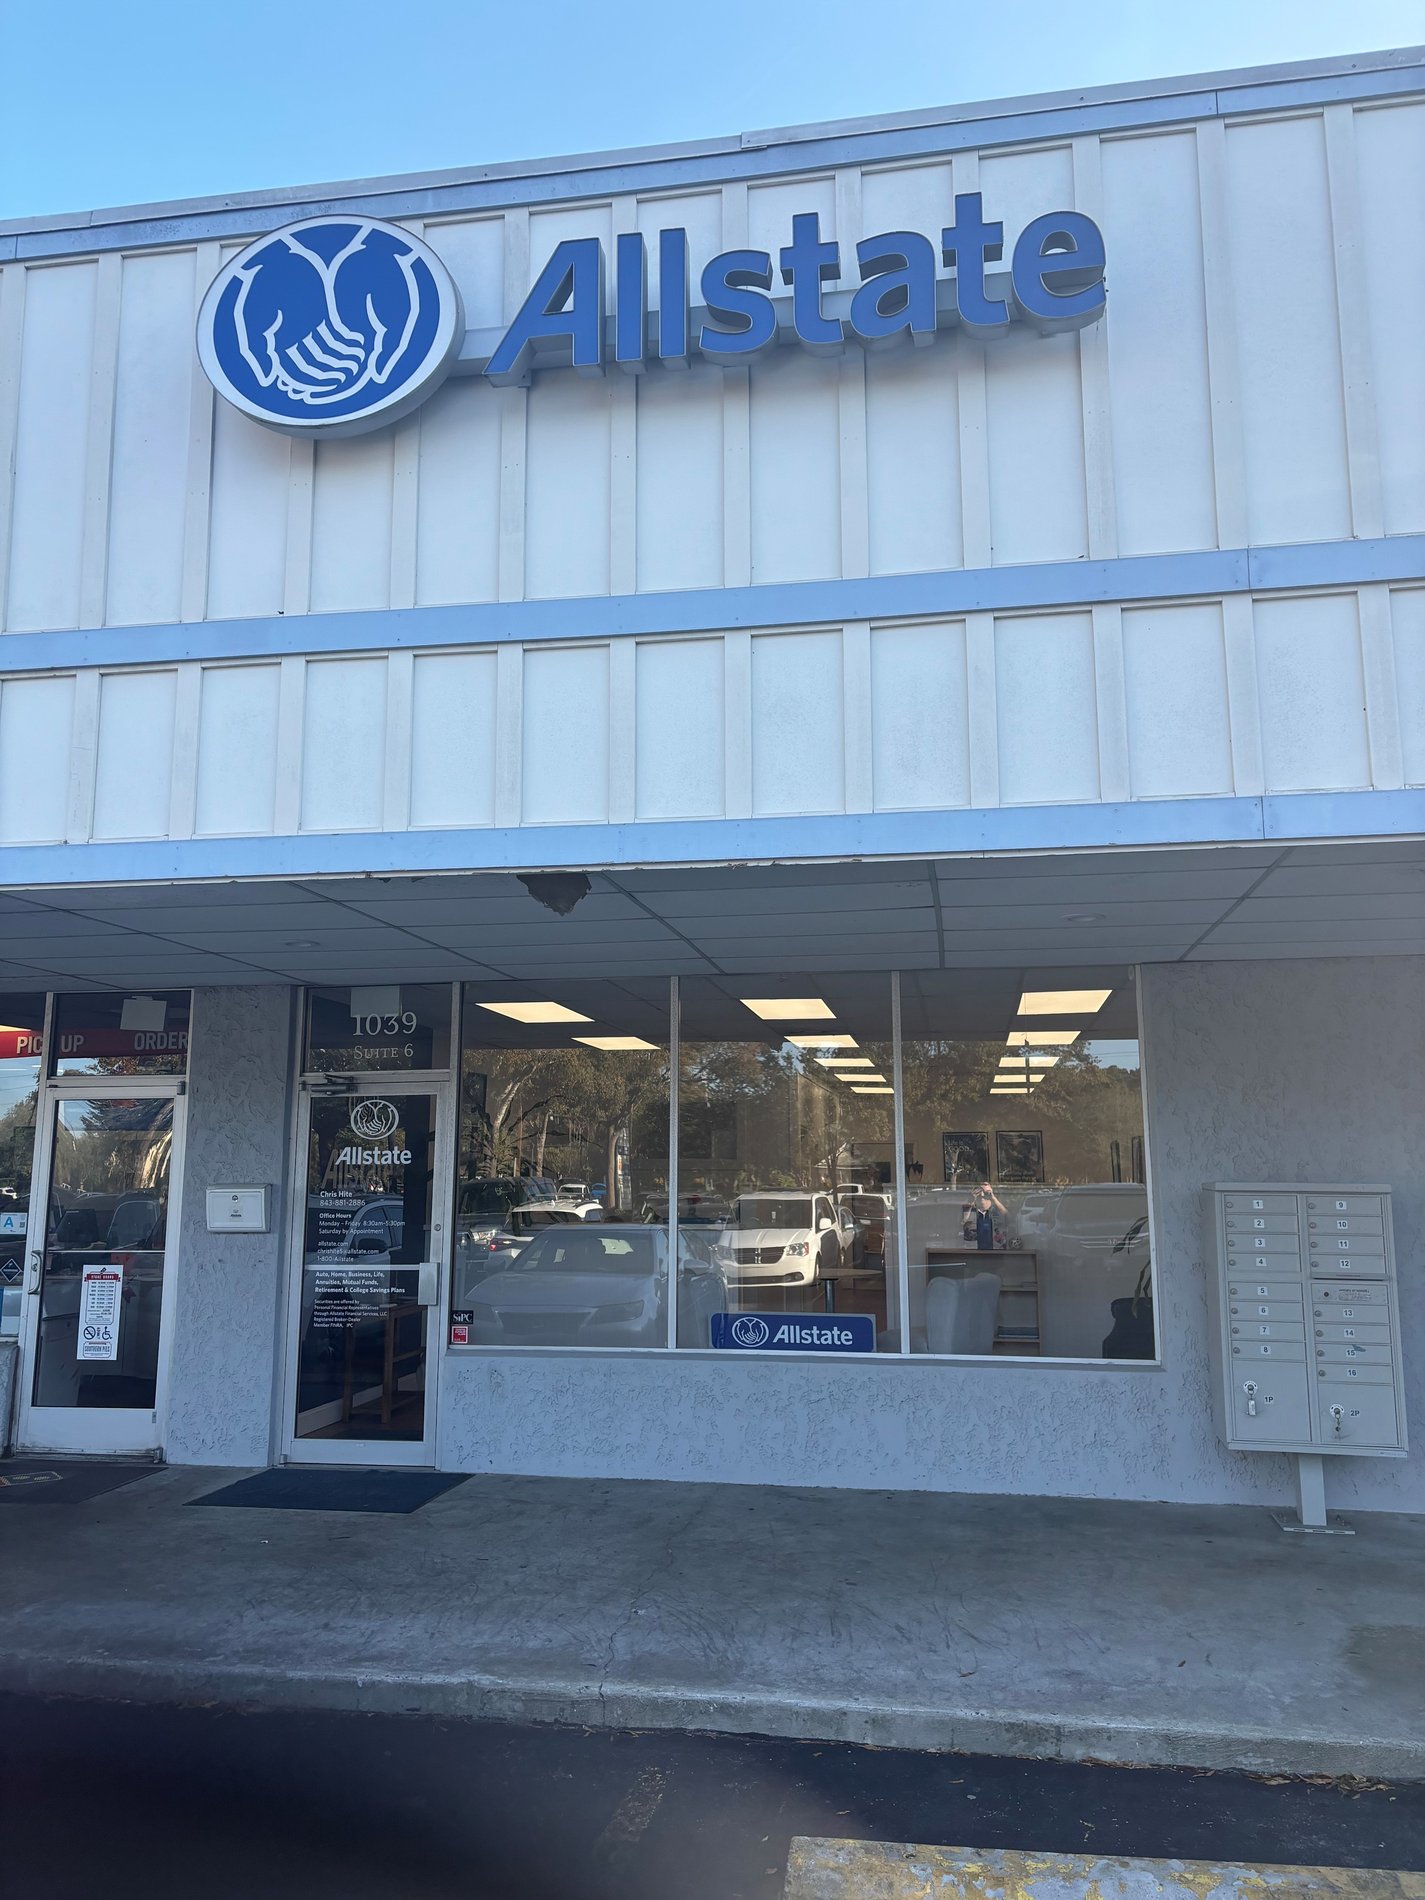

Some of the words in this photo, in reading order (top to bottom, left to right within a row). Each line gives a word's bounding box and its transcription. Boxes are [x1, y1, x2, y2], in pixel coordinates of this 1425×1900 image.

[483, 191, 1106, 380] Allstate
[353, 1011, 417, 1036] 1039
[16, 1036, 43, 1054] PIC
[60, 1035, 85, 1052] UP
[404, 1043, 414, 1057] 6
[336, 1147, 412, 1165] Allstate
[4, 1216, 14, 1227] A
[773, 1325, 853, 1345] Allstate
